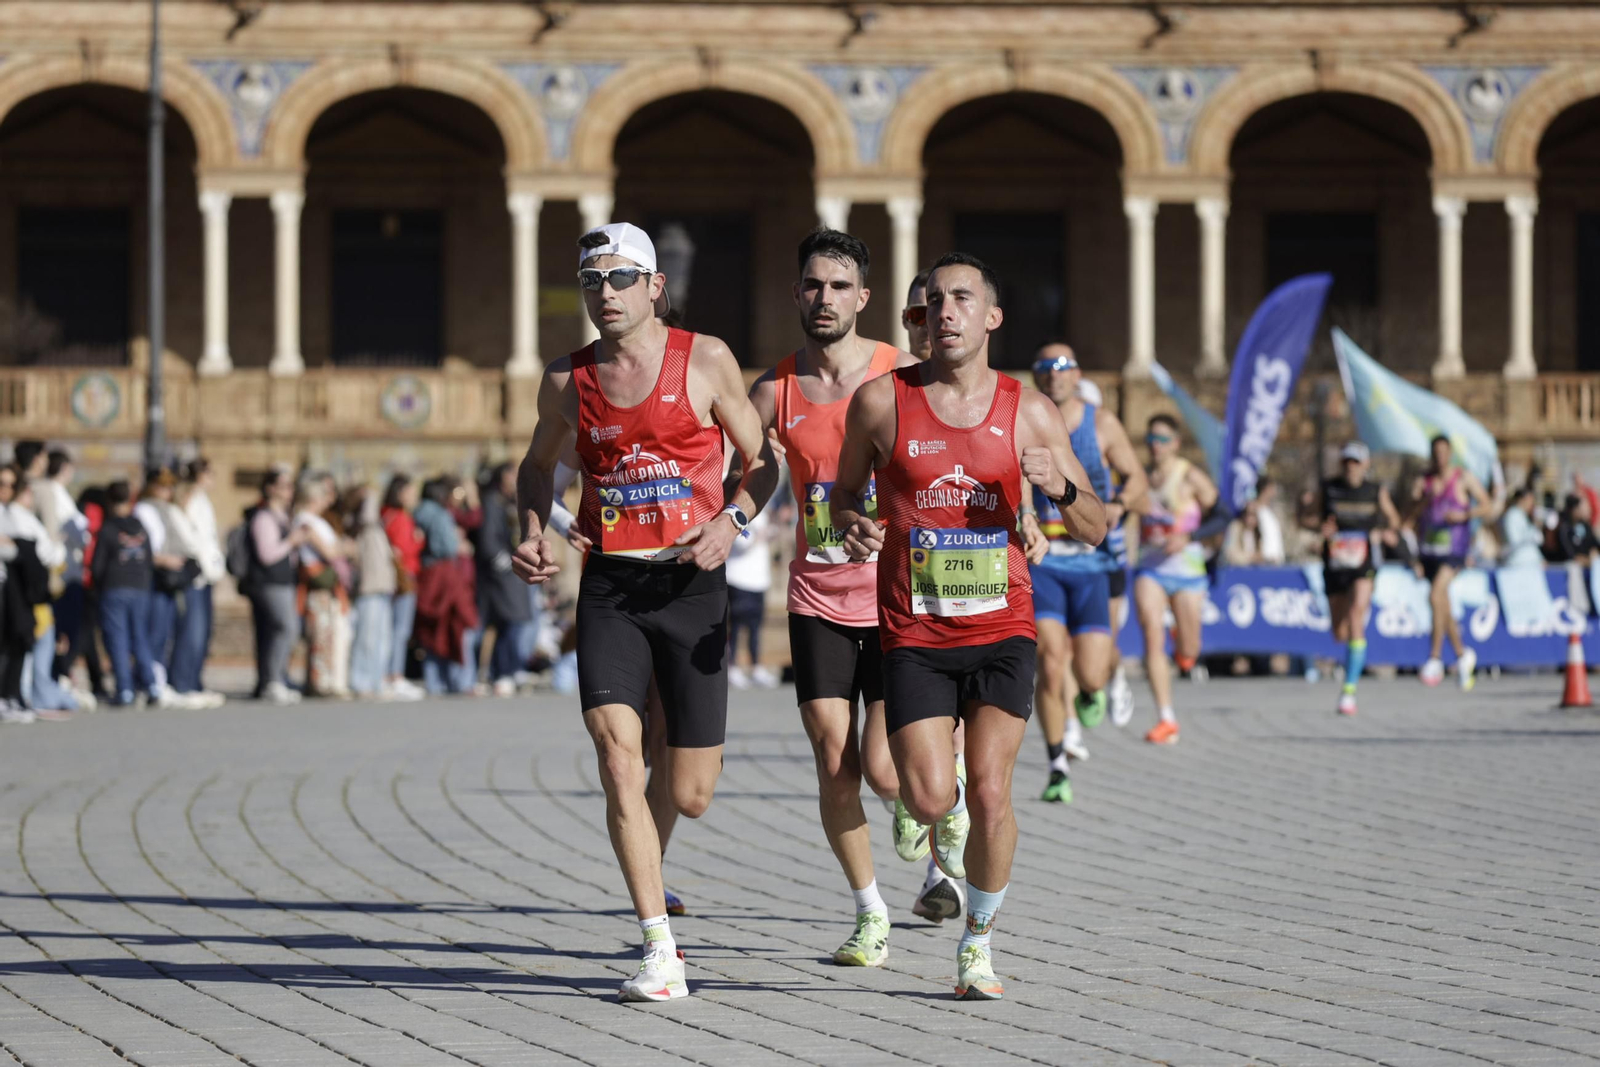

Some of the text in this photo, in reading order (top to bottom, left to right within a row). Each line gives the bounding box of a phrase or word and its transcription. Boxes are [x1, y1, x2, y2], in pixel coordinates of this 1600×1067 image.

[629, 483, 680, 501] ZURICH
[915, 488, 960, 509] CECINAS
[638, 511, 657, 525] 817
[943, 533, 997, 546] ZURICH
[944, 559, 974, 571] 2716
[913, 581, 1007, 596] JOSE RODRÍGUEZ
